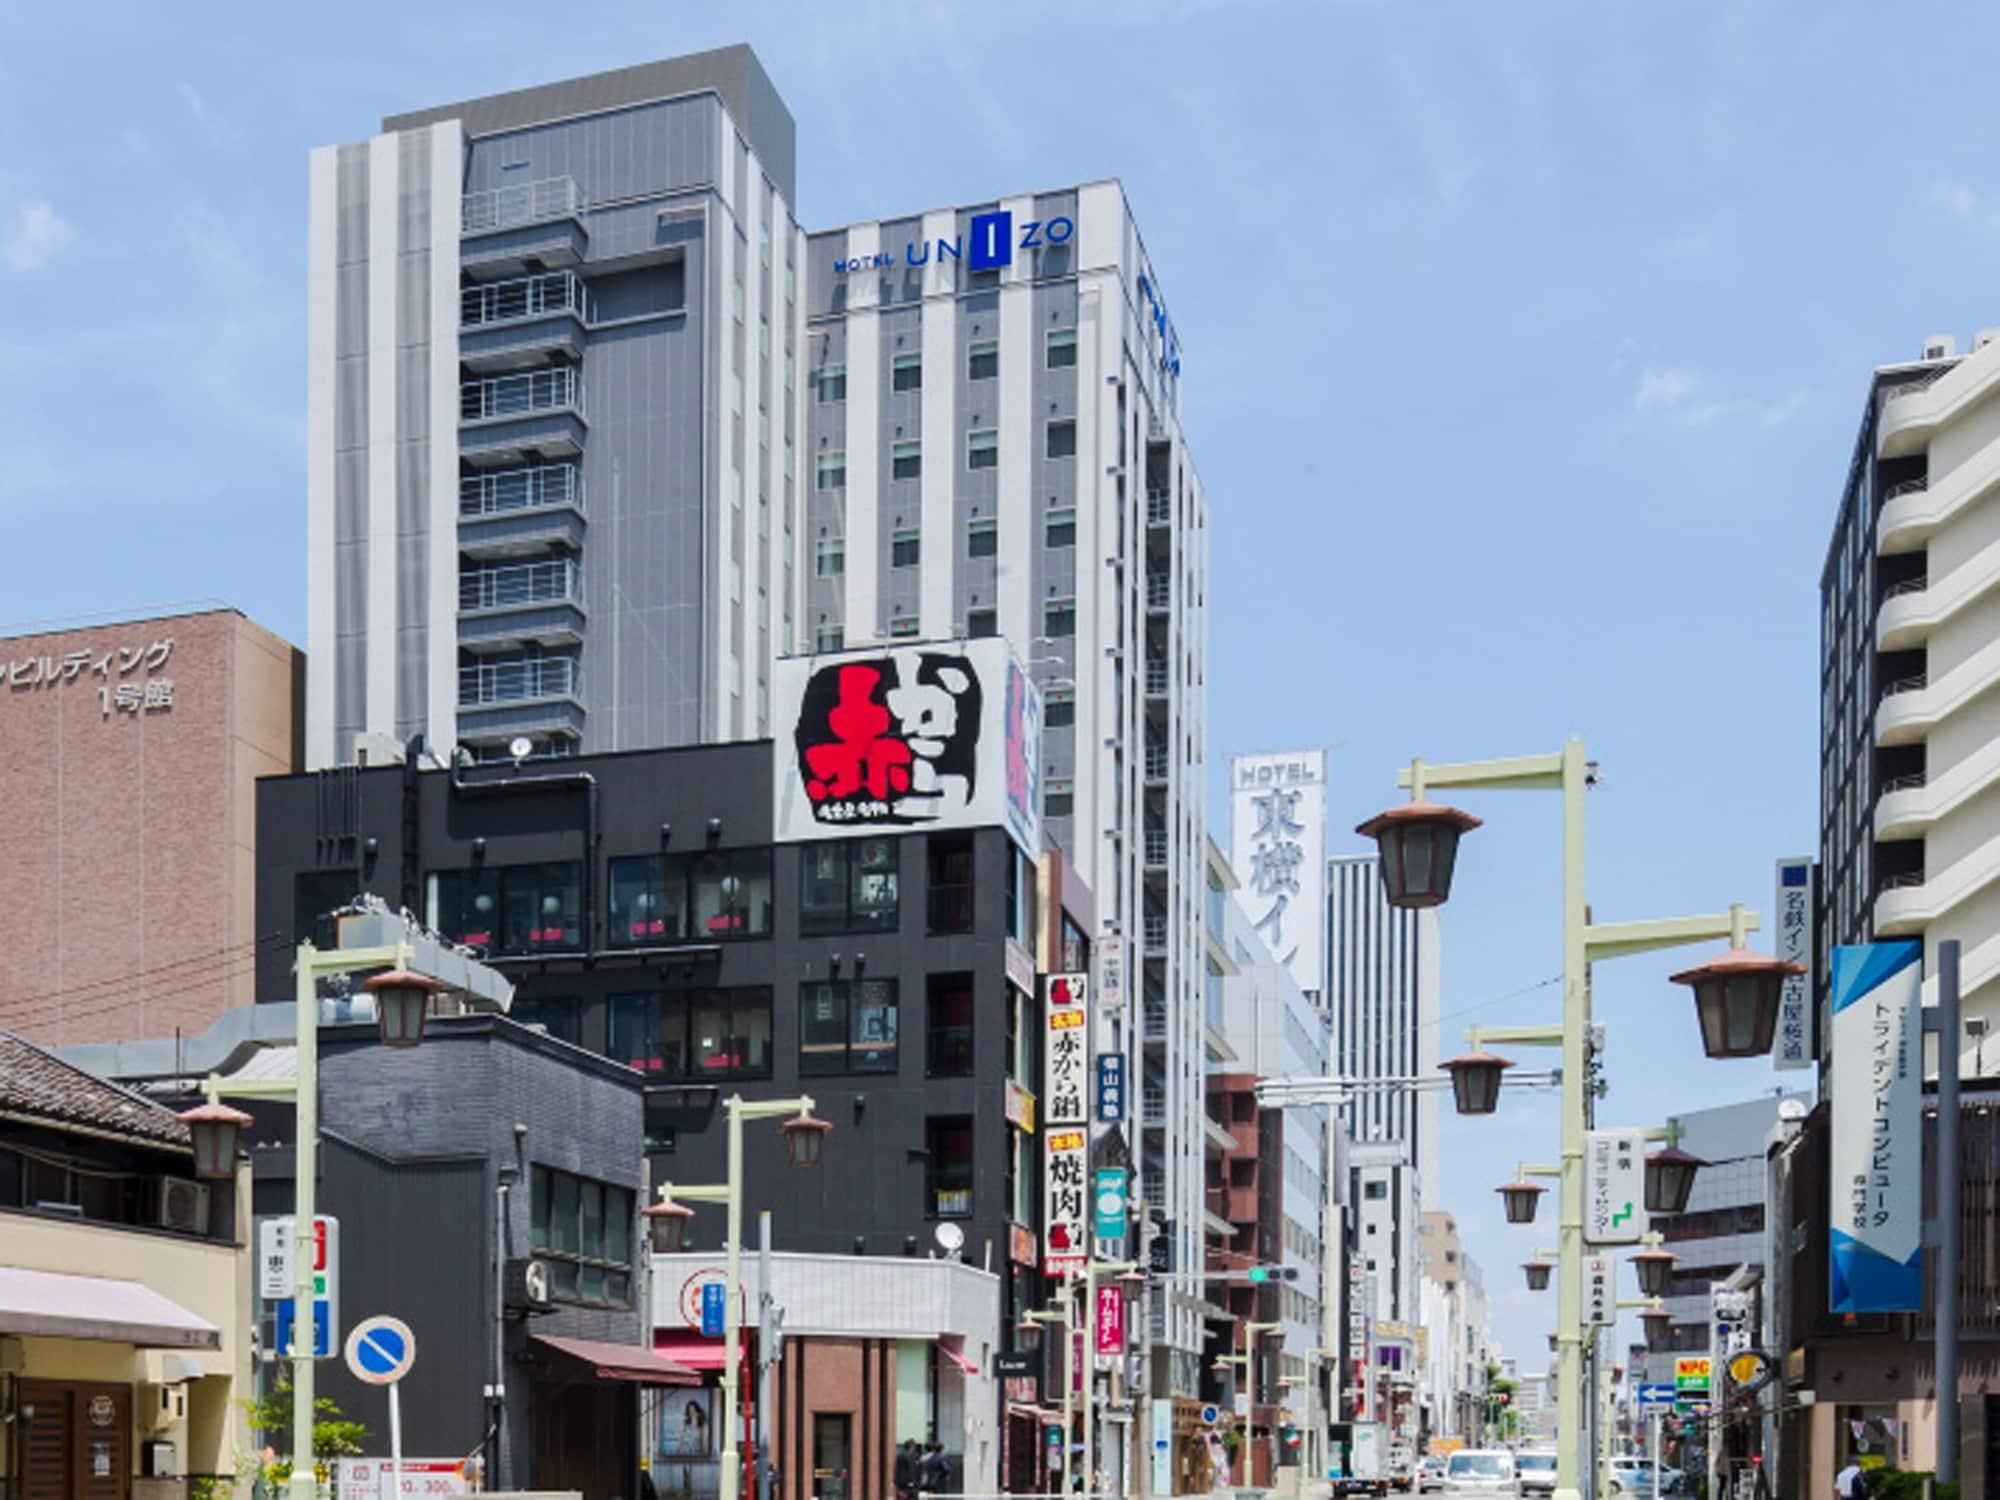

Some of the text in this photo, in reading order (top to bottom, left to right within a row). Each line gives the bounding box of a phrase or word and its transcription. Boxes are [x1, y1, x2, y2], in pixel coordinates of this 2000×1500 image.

[833, 211, 1075, 273] HOTEL UNIZO
[97, 680, 175, 720] 1号館
[1240, 763, 1315, 786] HOTEL
[1050, 1154, 1083, 1220] 焼肉
